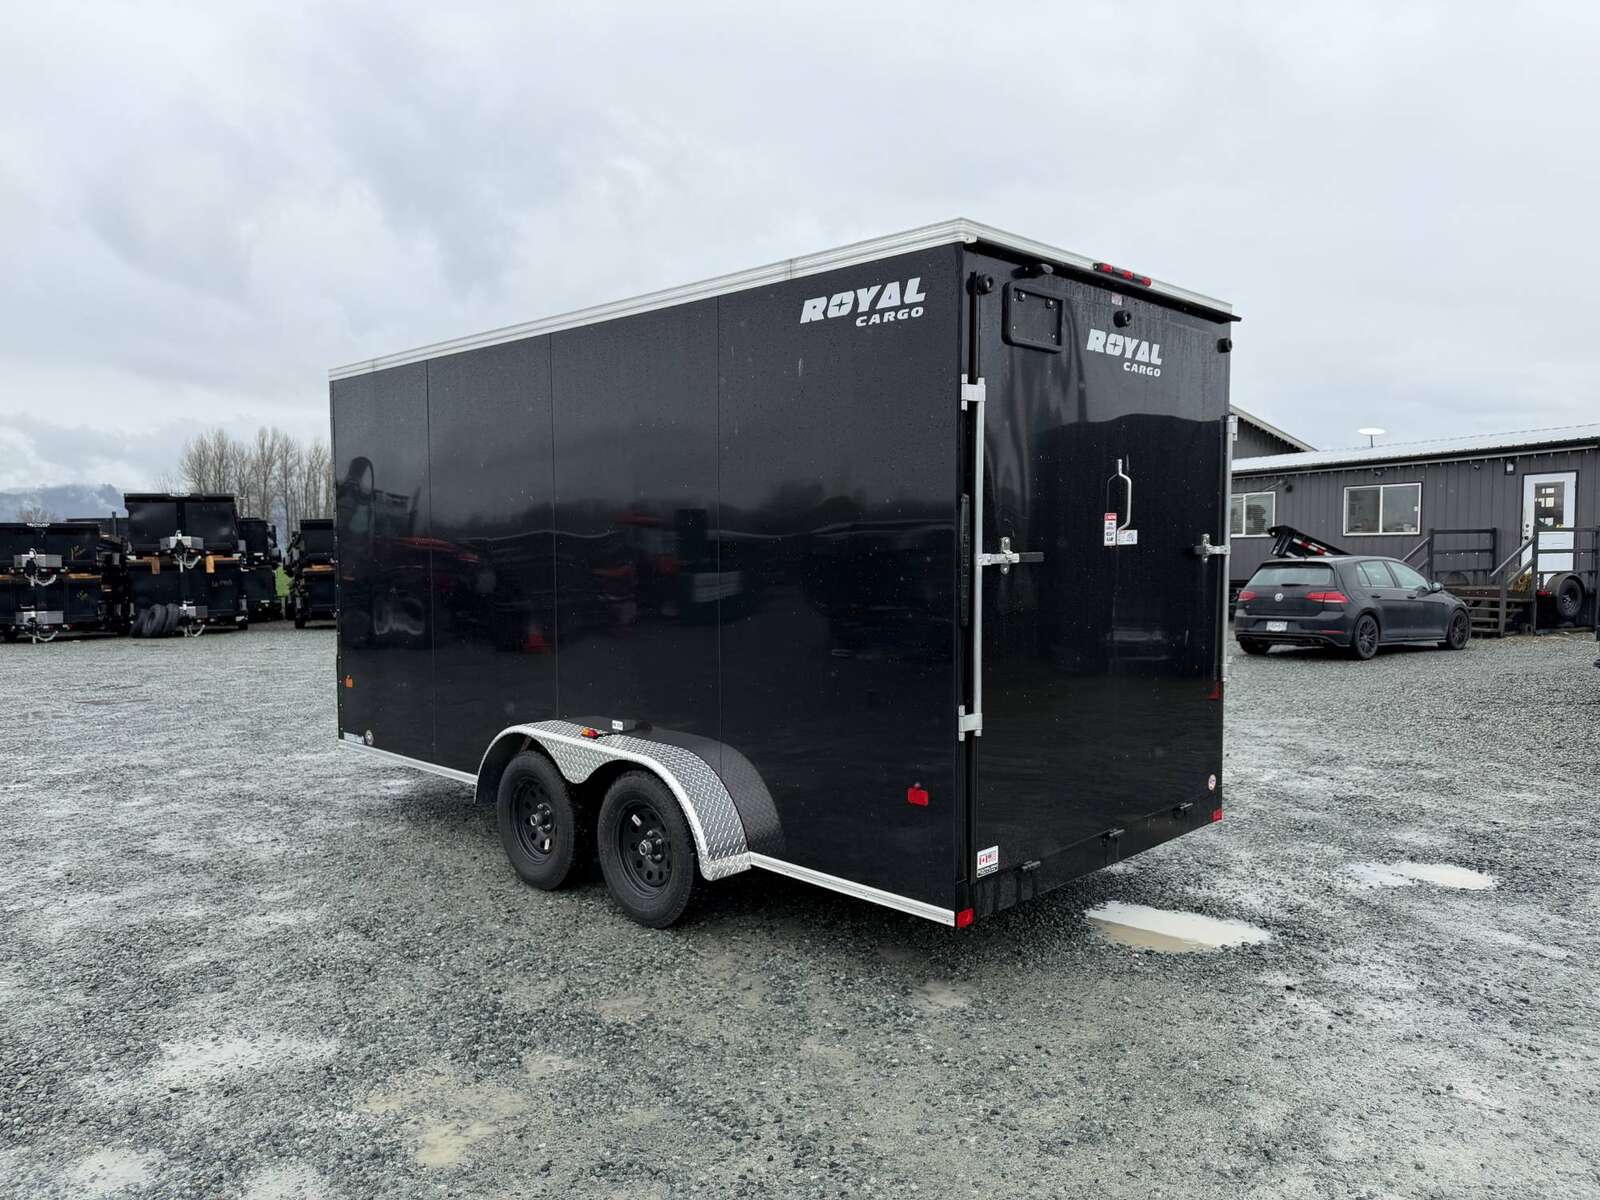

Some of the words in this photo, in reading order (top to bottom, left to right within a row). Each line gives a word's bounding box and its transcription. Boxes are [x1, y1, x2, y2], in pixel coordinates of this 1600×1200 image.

[800, 277, 926, 324] ROYAL
[855, 307, 924, 327] CARGO
[1086, 328, 1162, 365] ROYAL
[1123, 362, 1161, 377] CARGO
